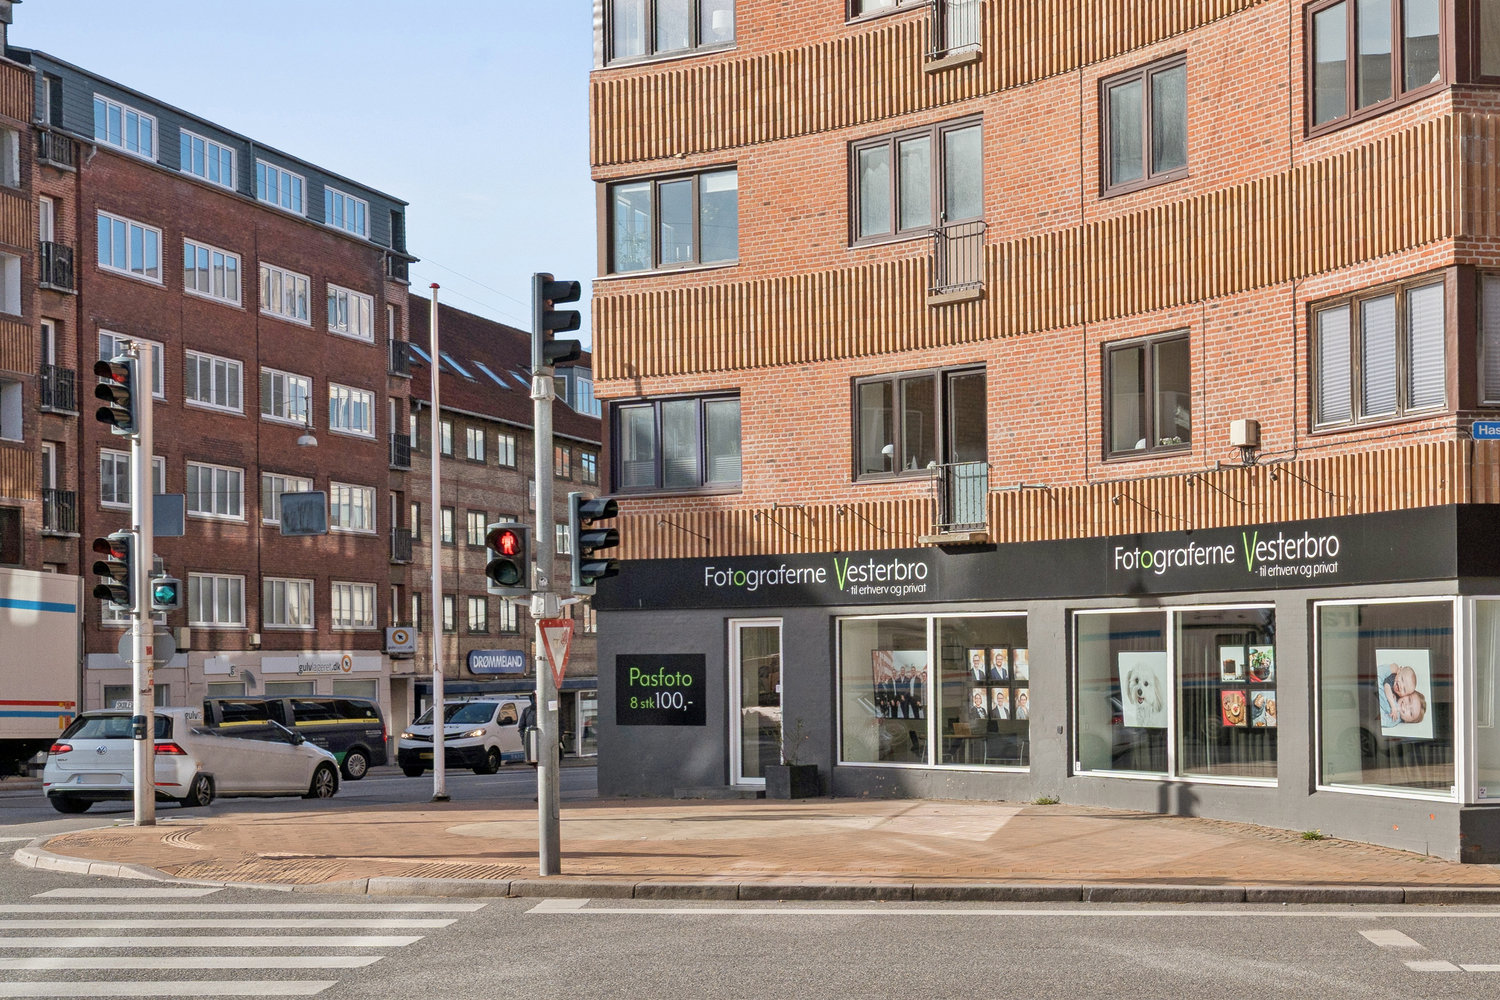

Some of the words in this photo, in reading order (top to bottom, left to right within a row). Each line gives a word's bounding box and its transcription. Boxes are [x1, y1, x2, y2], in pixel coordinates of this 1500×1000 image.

[1114, 541, 1236, 575] Fotograferne
[1242, 530, 1340, 573] Vesterbro
[704, 563, 827, 592] Fotograferne
[833, 557, 929, 592] Vesterbro
[1259, 565, 1268, 577] til
[1267, 563, 1300, 577] erhverv
[1299, 564, 1312, 578] og
[1313, 561, 1339, 578] privat
[850, 584, 859, 595] til
[858, 584, 890, 596] erhverv
[890, 585, 902, 597] og
[902, 582, 927, 597] privat
[298, 661, 341, 674] gulvlageret.dk
[472, 655, 524, 668] DRØMMELAND
[629, 666, 693, 687] Pasfoto
[630, 696, 638, 709] 8
[640, 696, 655, 709] stk
[655, 691, 693, 712] 100,-
